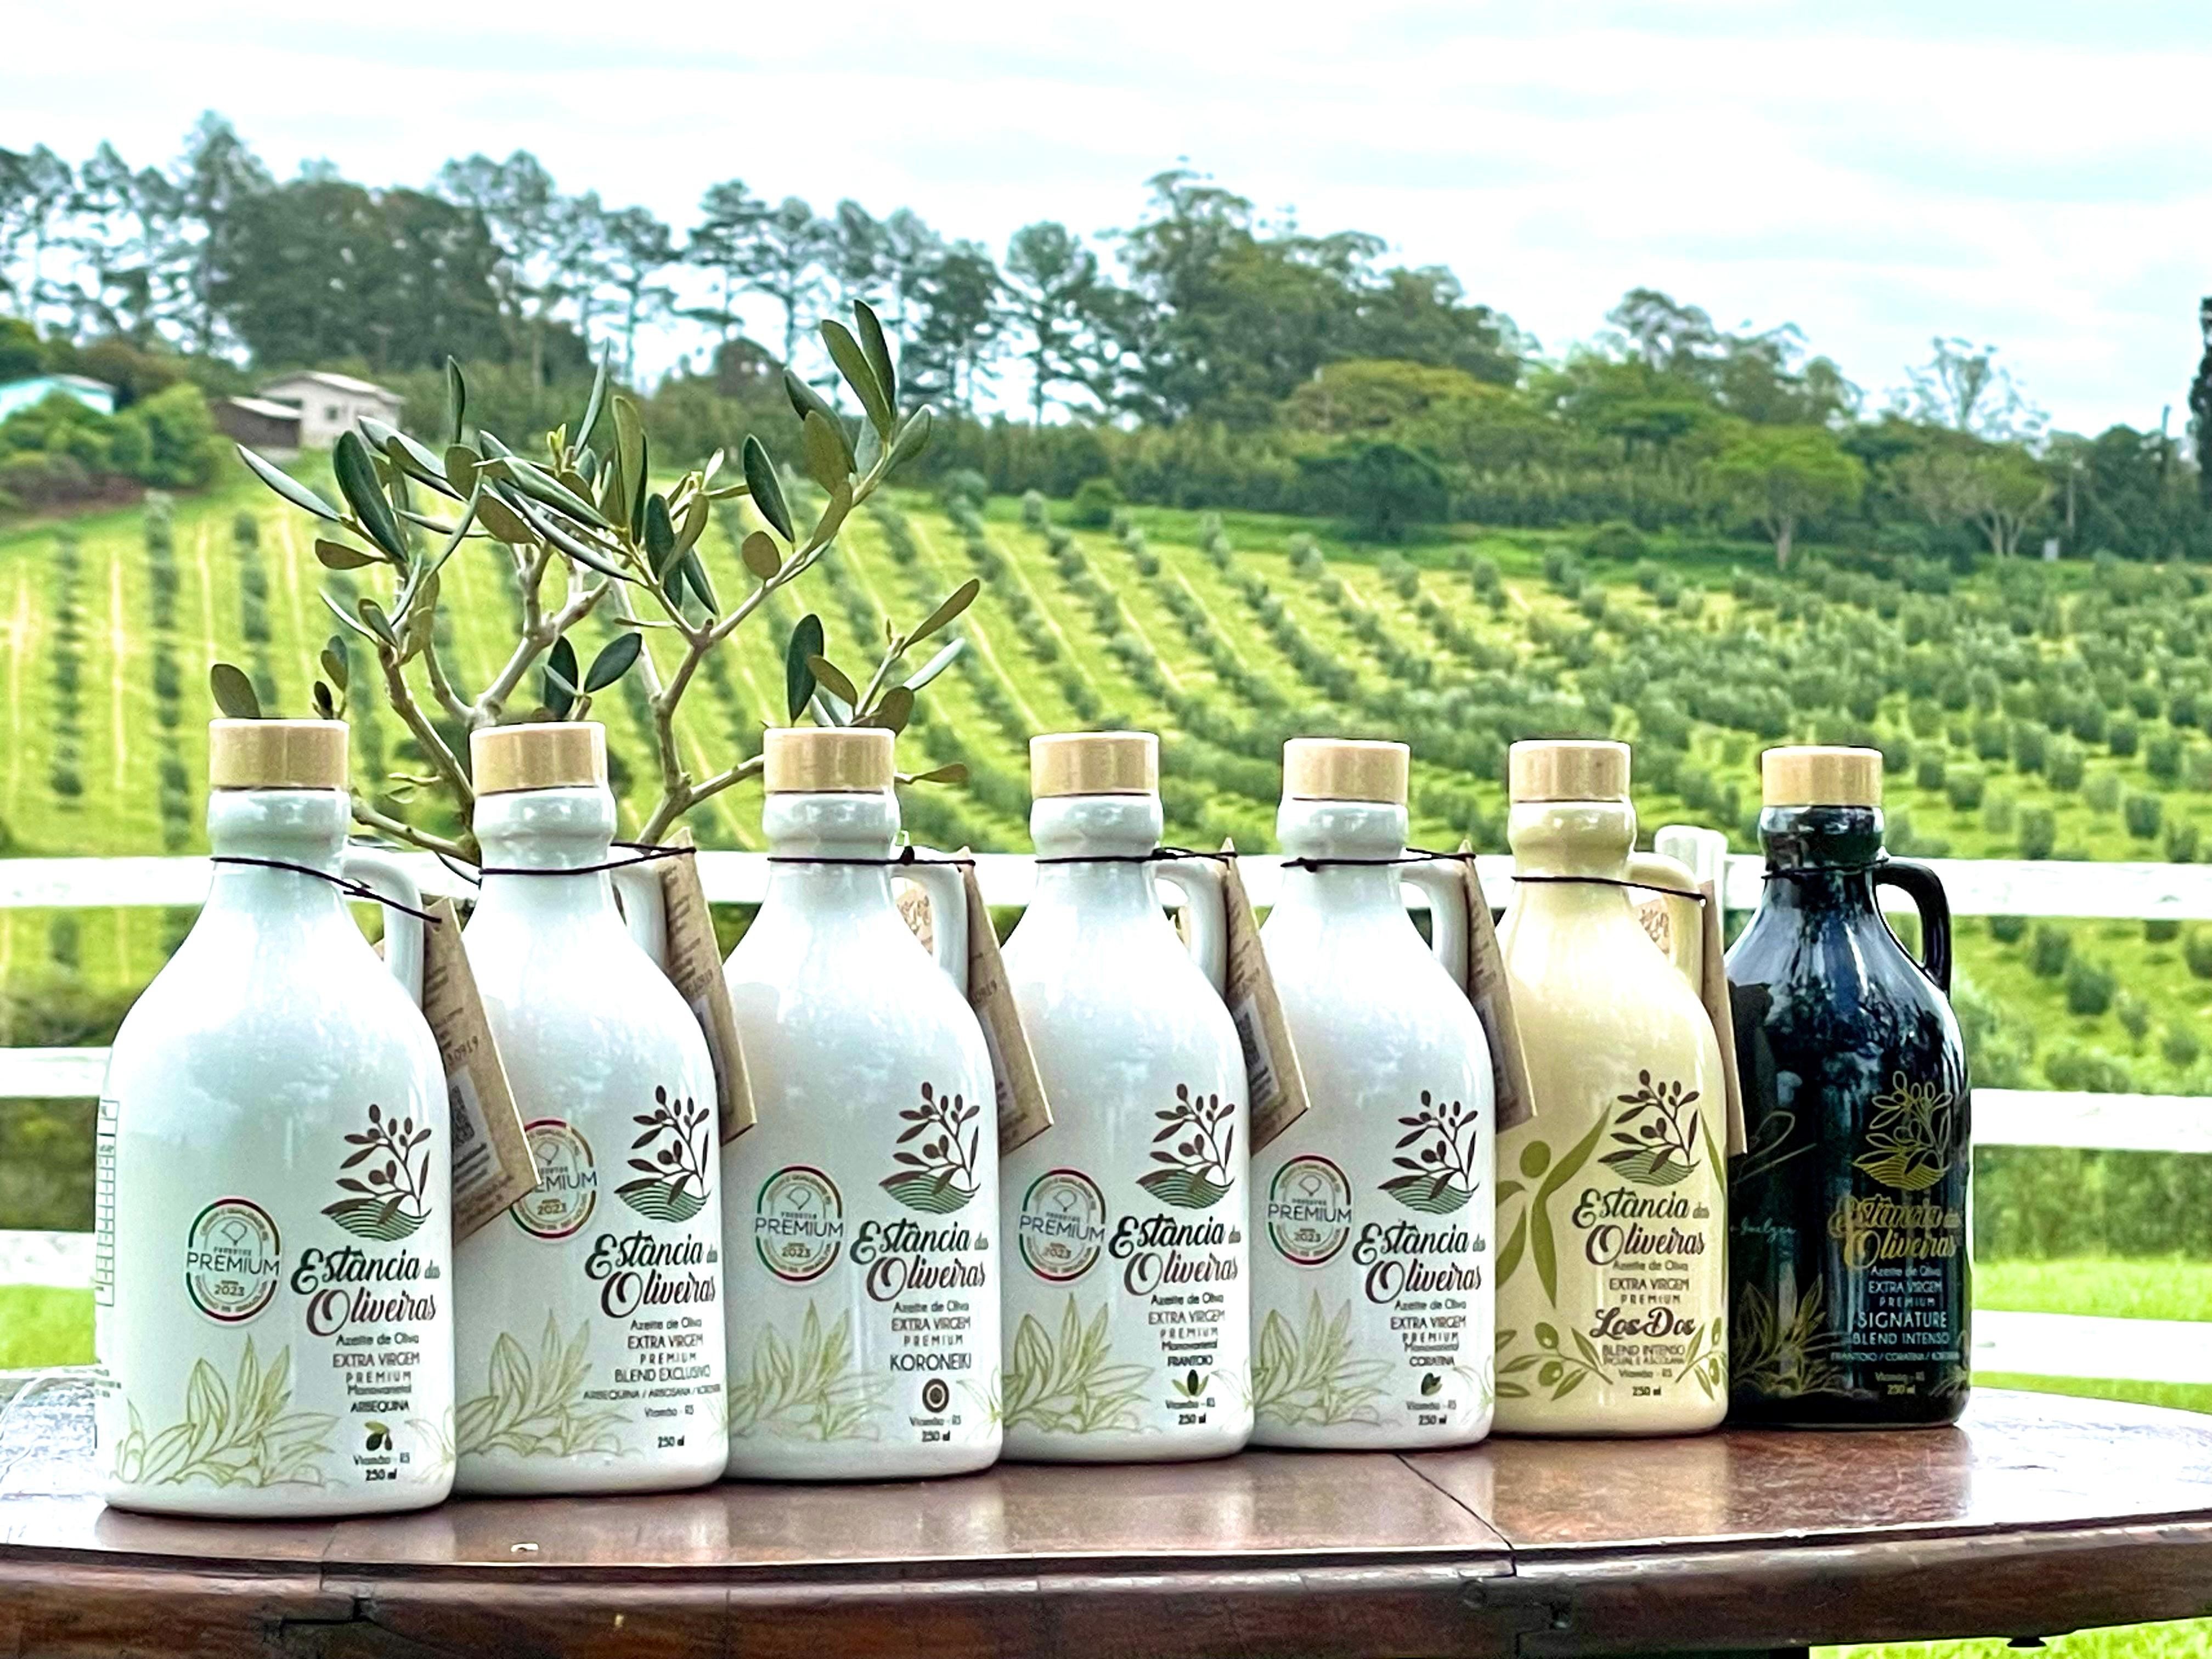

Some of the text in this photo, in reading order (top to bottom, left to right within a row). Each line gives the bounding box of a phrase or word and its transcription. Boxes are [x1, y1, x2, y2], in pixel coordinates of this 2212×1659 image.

[1268, 1203, 1352, 1223] PREMIUM
[1572, 1187, 1690, 1229] Estância
[755, 1217, 843, 1238] PREMIUM
[1019, 1214, 1105, 1242] PREMIUM
[1108, 1213, 1226, 1259] Estância
[850, 1218, 970, 1265] Estância
[1352, 1220, 1469, 1265] Estância
[1586, 1222, 1705, 1265] Oliveiras
[1844, 1228, 1957, 1270] Oliveiras
[585, 1230, 704, 1280] Estância
[187, 1251, 280, 1277] PREMIUM
[290, 1245, 421, 1295] Estância
[1124, 1249, 1238, 1296] Oliveiras
[866, 1254, 985, 1301] Oliveiras
[1365, 1258, 1481, 1304] Oliveiras
[1610, 1278, 1647, 1290] EXTRA
[214, 1284, 245, 1296] 2023
[601, 1268, 715, 1318] Oliveiras
[1869, 1281, 1904, 1294] EXTRA
[1621, 1294, 1680, 1305] PREMIUM
[1880, 1297, 1936, 1307] PREMIUM
[306, 1286, 436, 1336] Oliveiras
[1148, 1311, 1186, 1325] EXTRA
[891, 1318, 930, 1331] EXTRA
[1390, 1317, 1427, 1330] EXTRA
[1858, 1312, 1947, 1329] SIGNATURE
[904, 1334, 963, 1346] PREMIUM
[1160, 1327, 1218, 1339] PREMIUM
[1402, 1331, 1459, 1342] PREMIUM
[1853, 1332, 1949, 1345] BLEND INTENSO
[628, 1335, 666, 1350] EXTRA
[333, 1353, 375, 1368] EXTRA
[640, 1352, 696, 1364] PREMIUM
[346, 1372, 411, 1383] PREMIUM
[614, 1369, 656, 1383] BLEND
